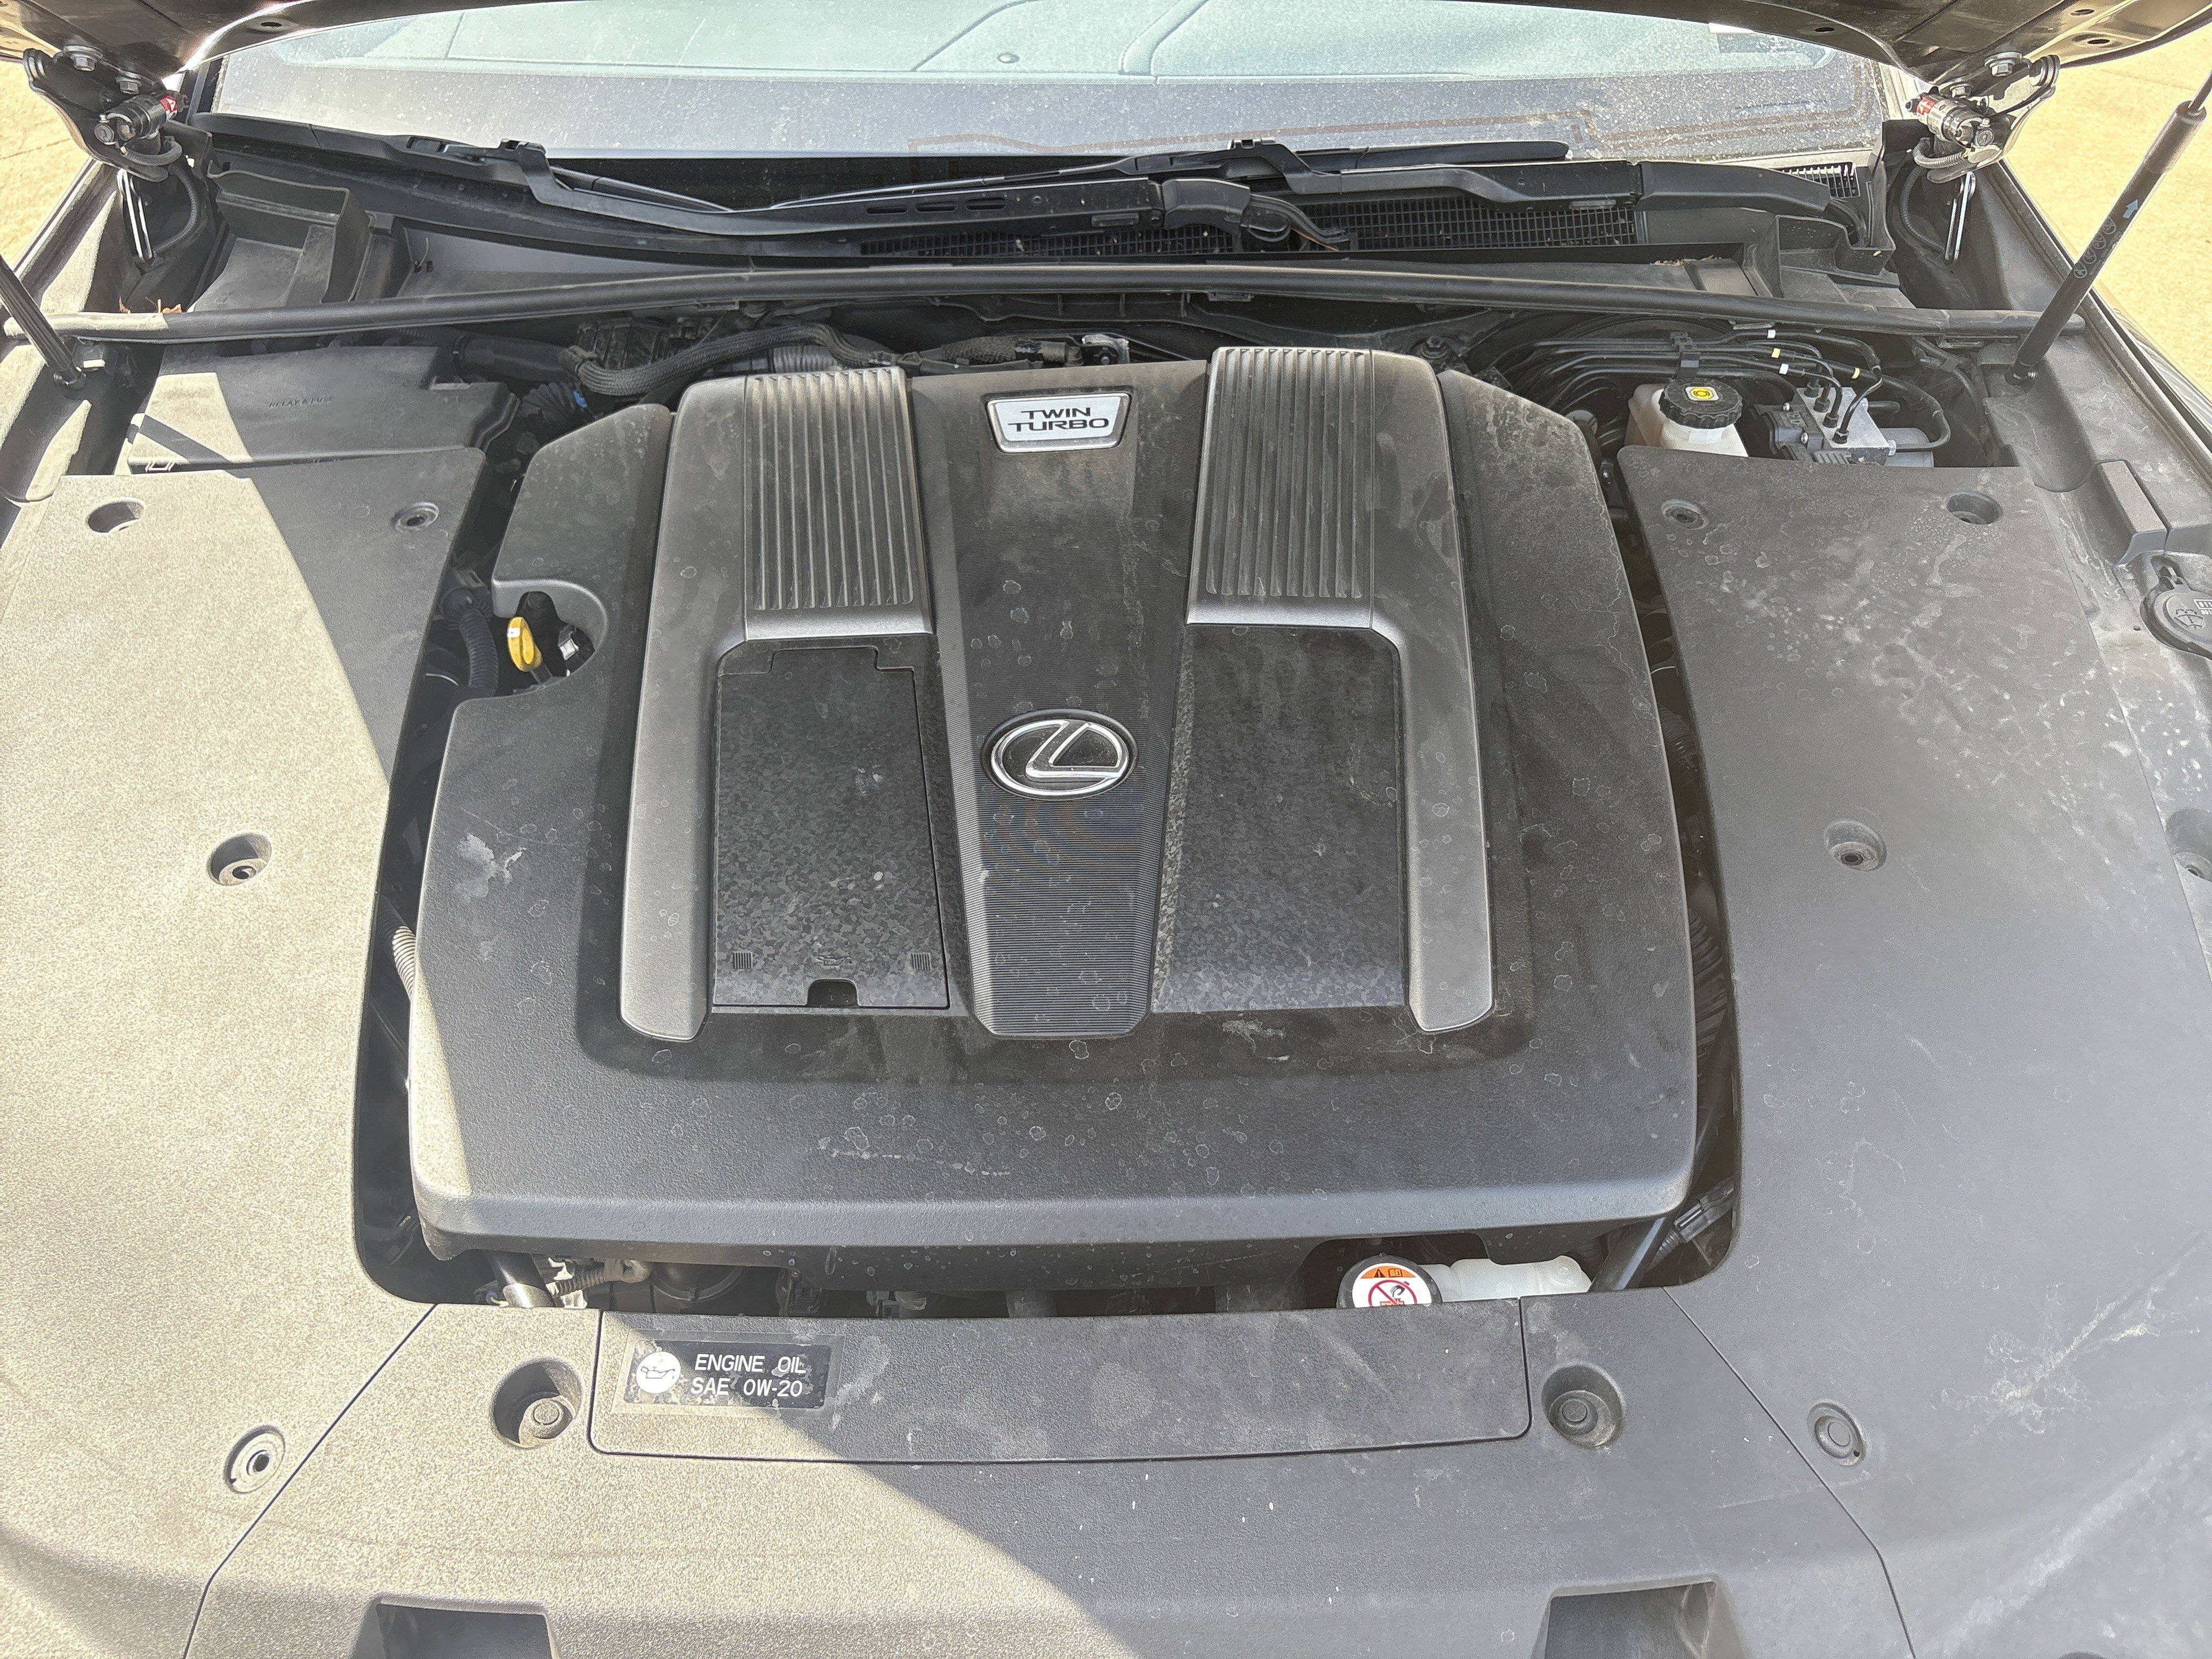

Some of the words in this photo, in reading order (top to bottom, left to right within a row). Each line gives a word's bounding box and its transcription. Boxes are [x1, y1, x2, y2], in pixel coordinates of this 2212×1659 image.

[1020, 407, 1091, 420] TWIN
[1008, 417, 1109, 432] TURBO
[695, 1353, 765, 1373] ENGINE
[777, 1356, 806, 1374] OIL
[691, 1376, 731, 1396] SAE
[743, 1379, 803, 1397] 0W-20
